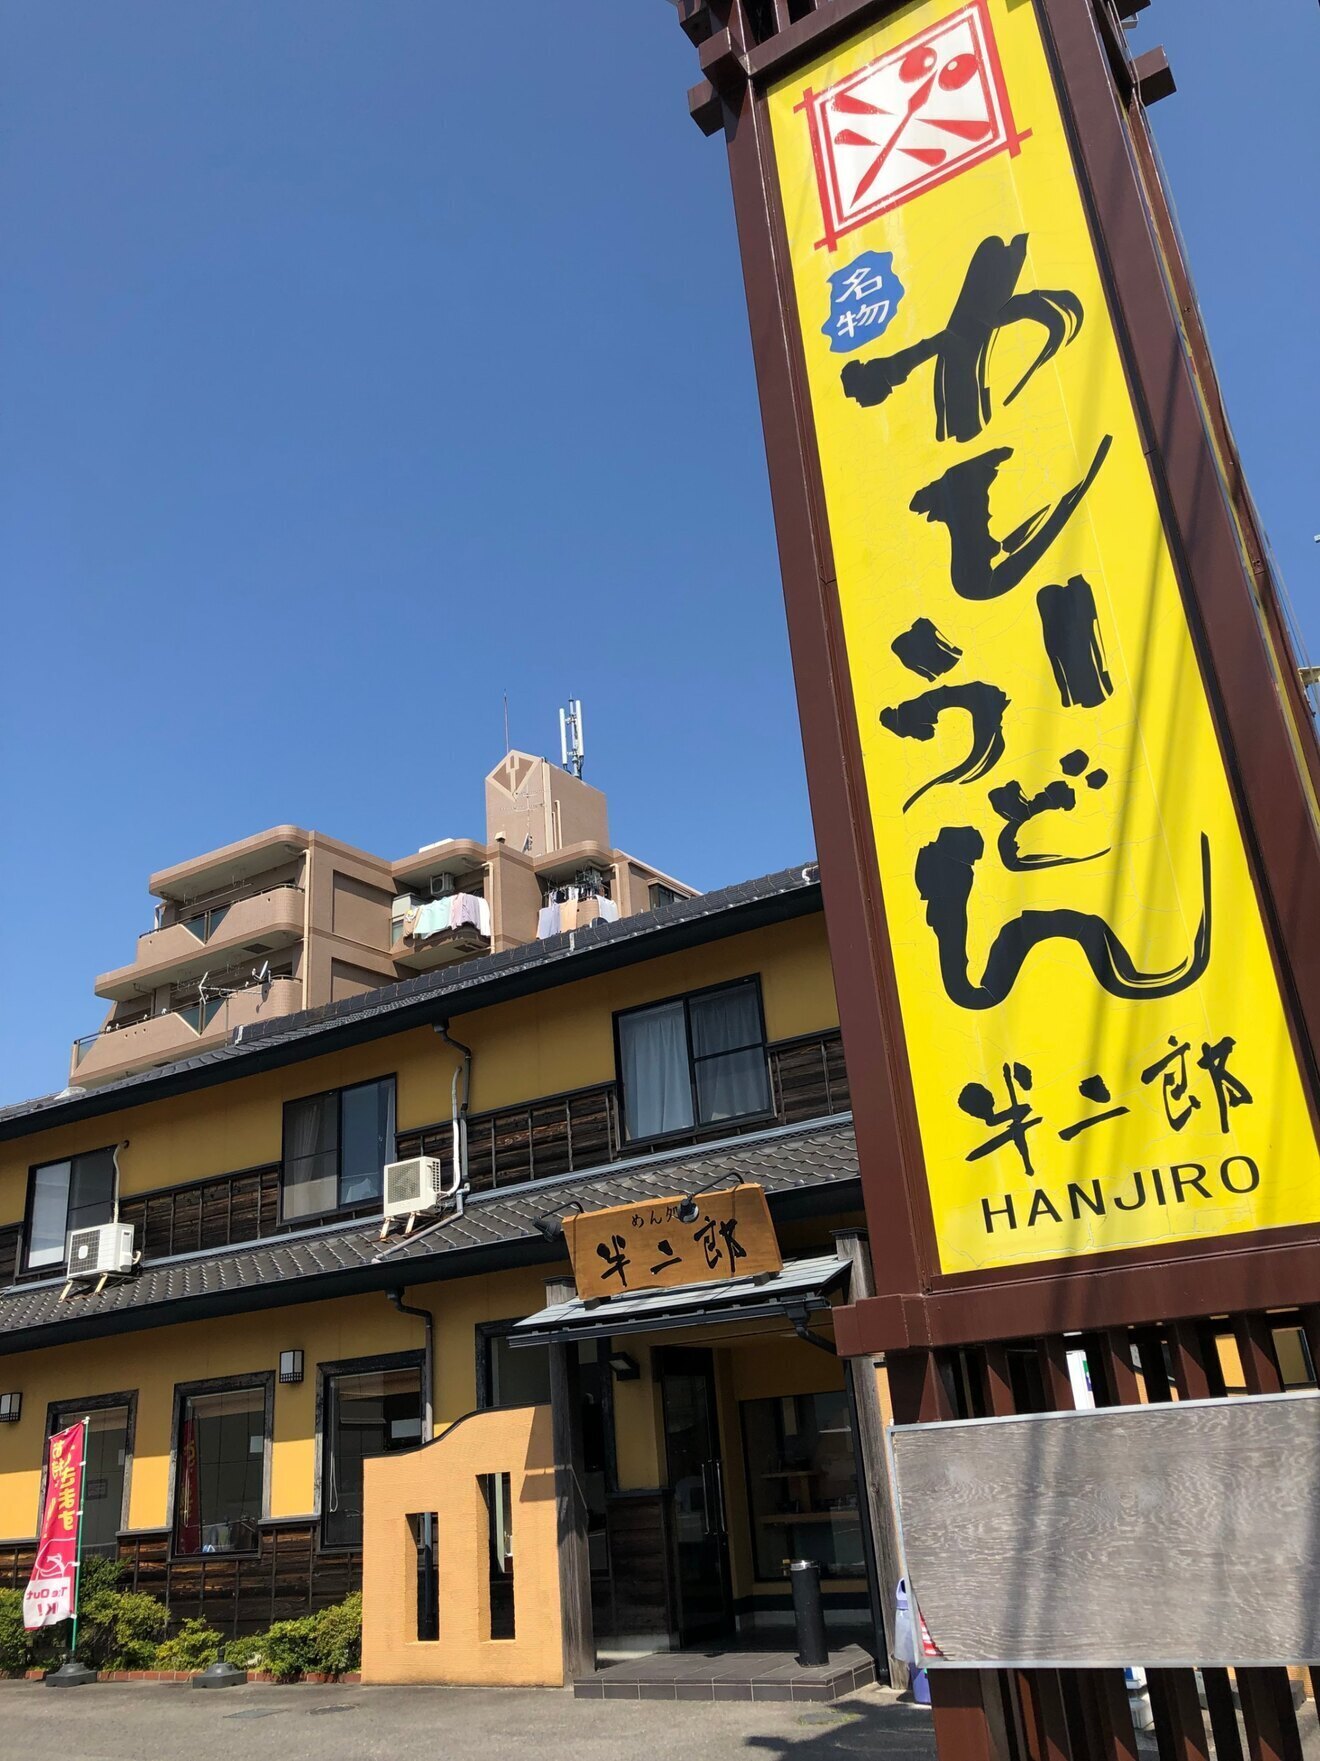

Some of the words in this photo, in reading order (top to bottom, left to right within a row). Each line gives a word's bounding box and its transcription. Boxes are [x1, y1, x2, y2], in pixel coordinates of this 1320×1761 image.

[835, 267, 889, 338] 名物
[840, 233, 1211, 1010] カレーうどん
[958, 1035, 1253, 1176] 半二郎
[981, 1155, 1260, 1234] HANJIRO
[597, 1216, 747, 1287] 半二郎
